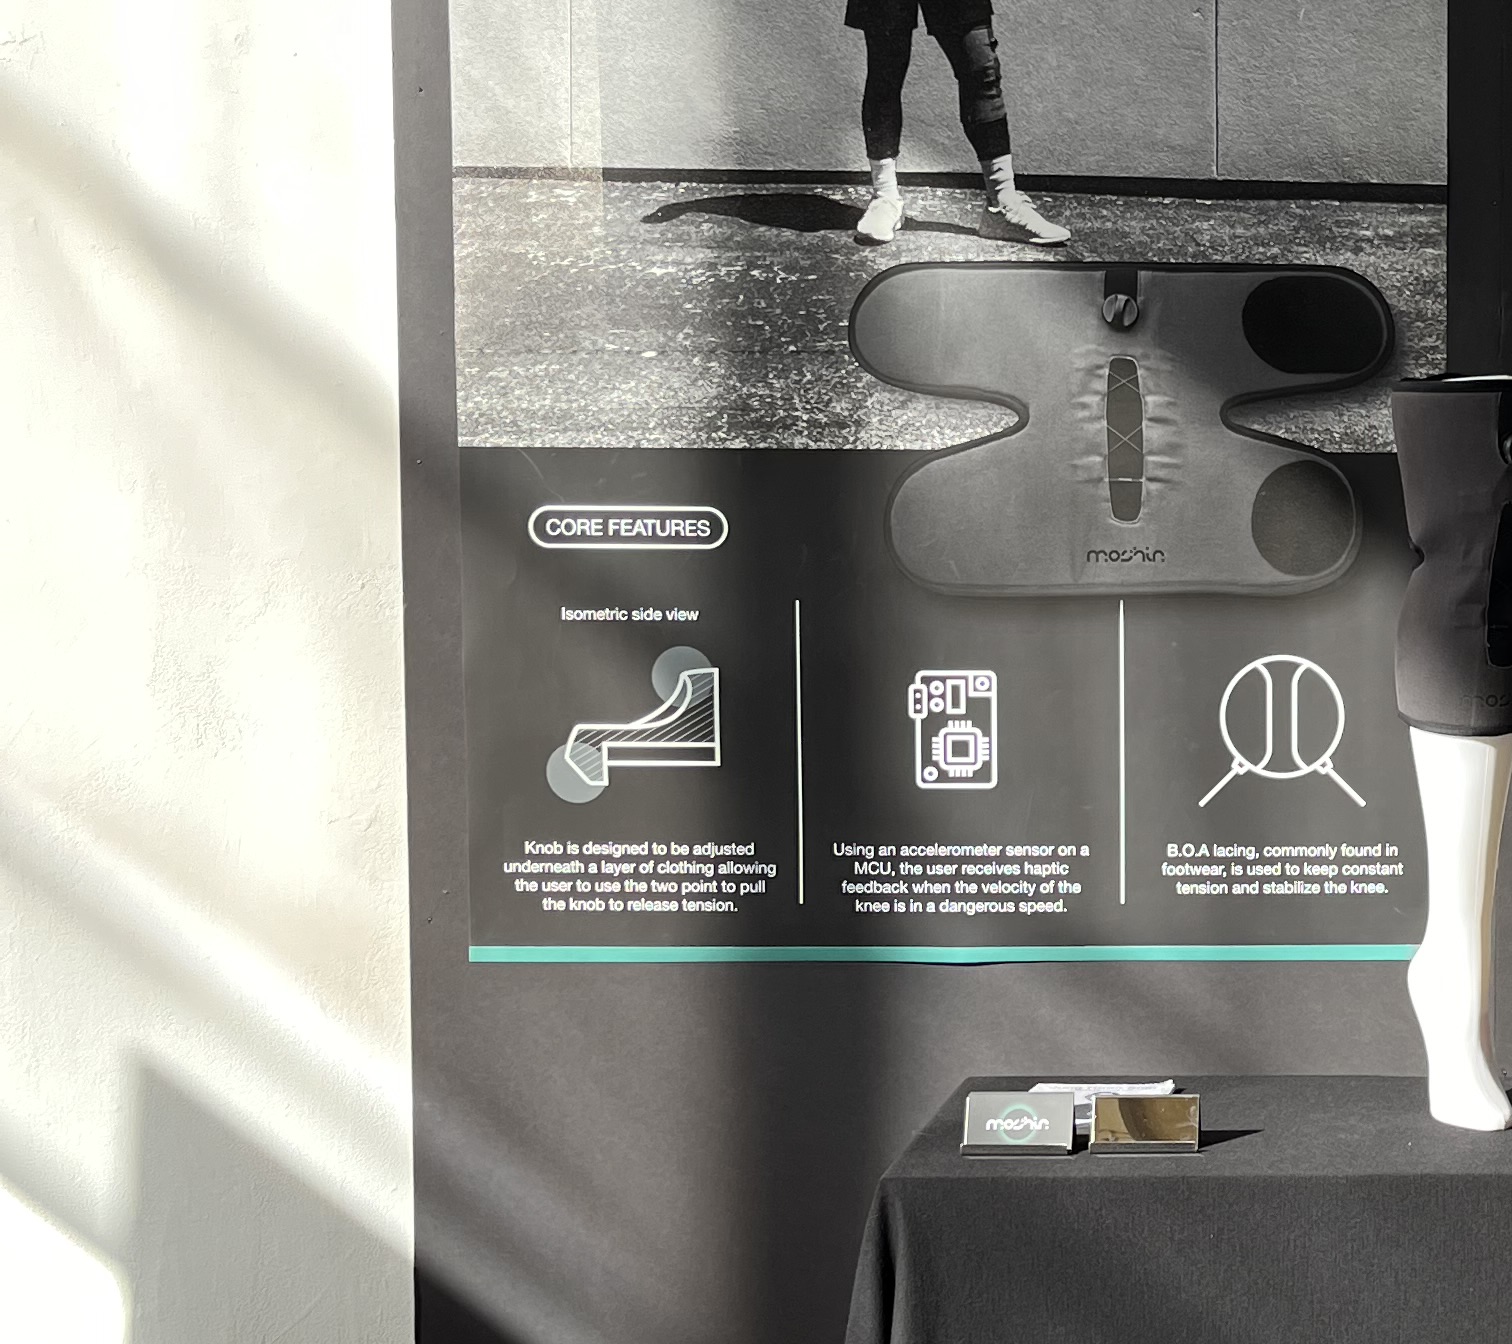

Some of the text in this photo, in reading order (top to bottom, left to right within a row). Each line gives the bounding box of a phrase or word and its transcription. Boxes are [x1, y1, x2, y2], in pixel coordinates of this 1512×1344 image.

[545, 518, 710, 536] CORE FEATURES
[1086, 546, 1165, 563] moshin
[561, 606, 699, 621] Isometric side view
[524, 840, 754, 858] Knob is designed to be adjusted
[1167, 842, 1398, 860] B.O.A lacing, commonly found in
[503, 859, 776, 877] underneath a layer of clothing allowing
[1161, 861, 1403, 878] footwear, is used to keep constant
[514, 877, 765, 895] the user to use the two point to pull
[1175, 880, 1388, 894] tension and stabilize the knee.
[542, 896, 738, 911] the knob to release tension.
